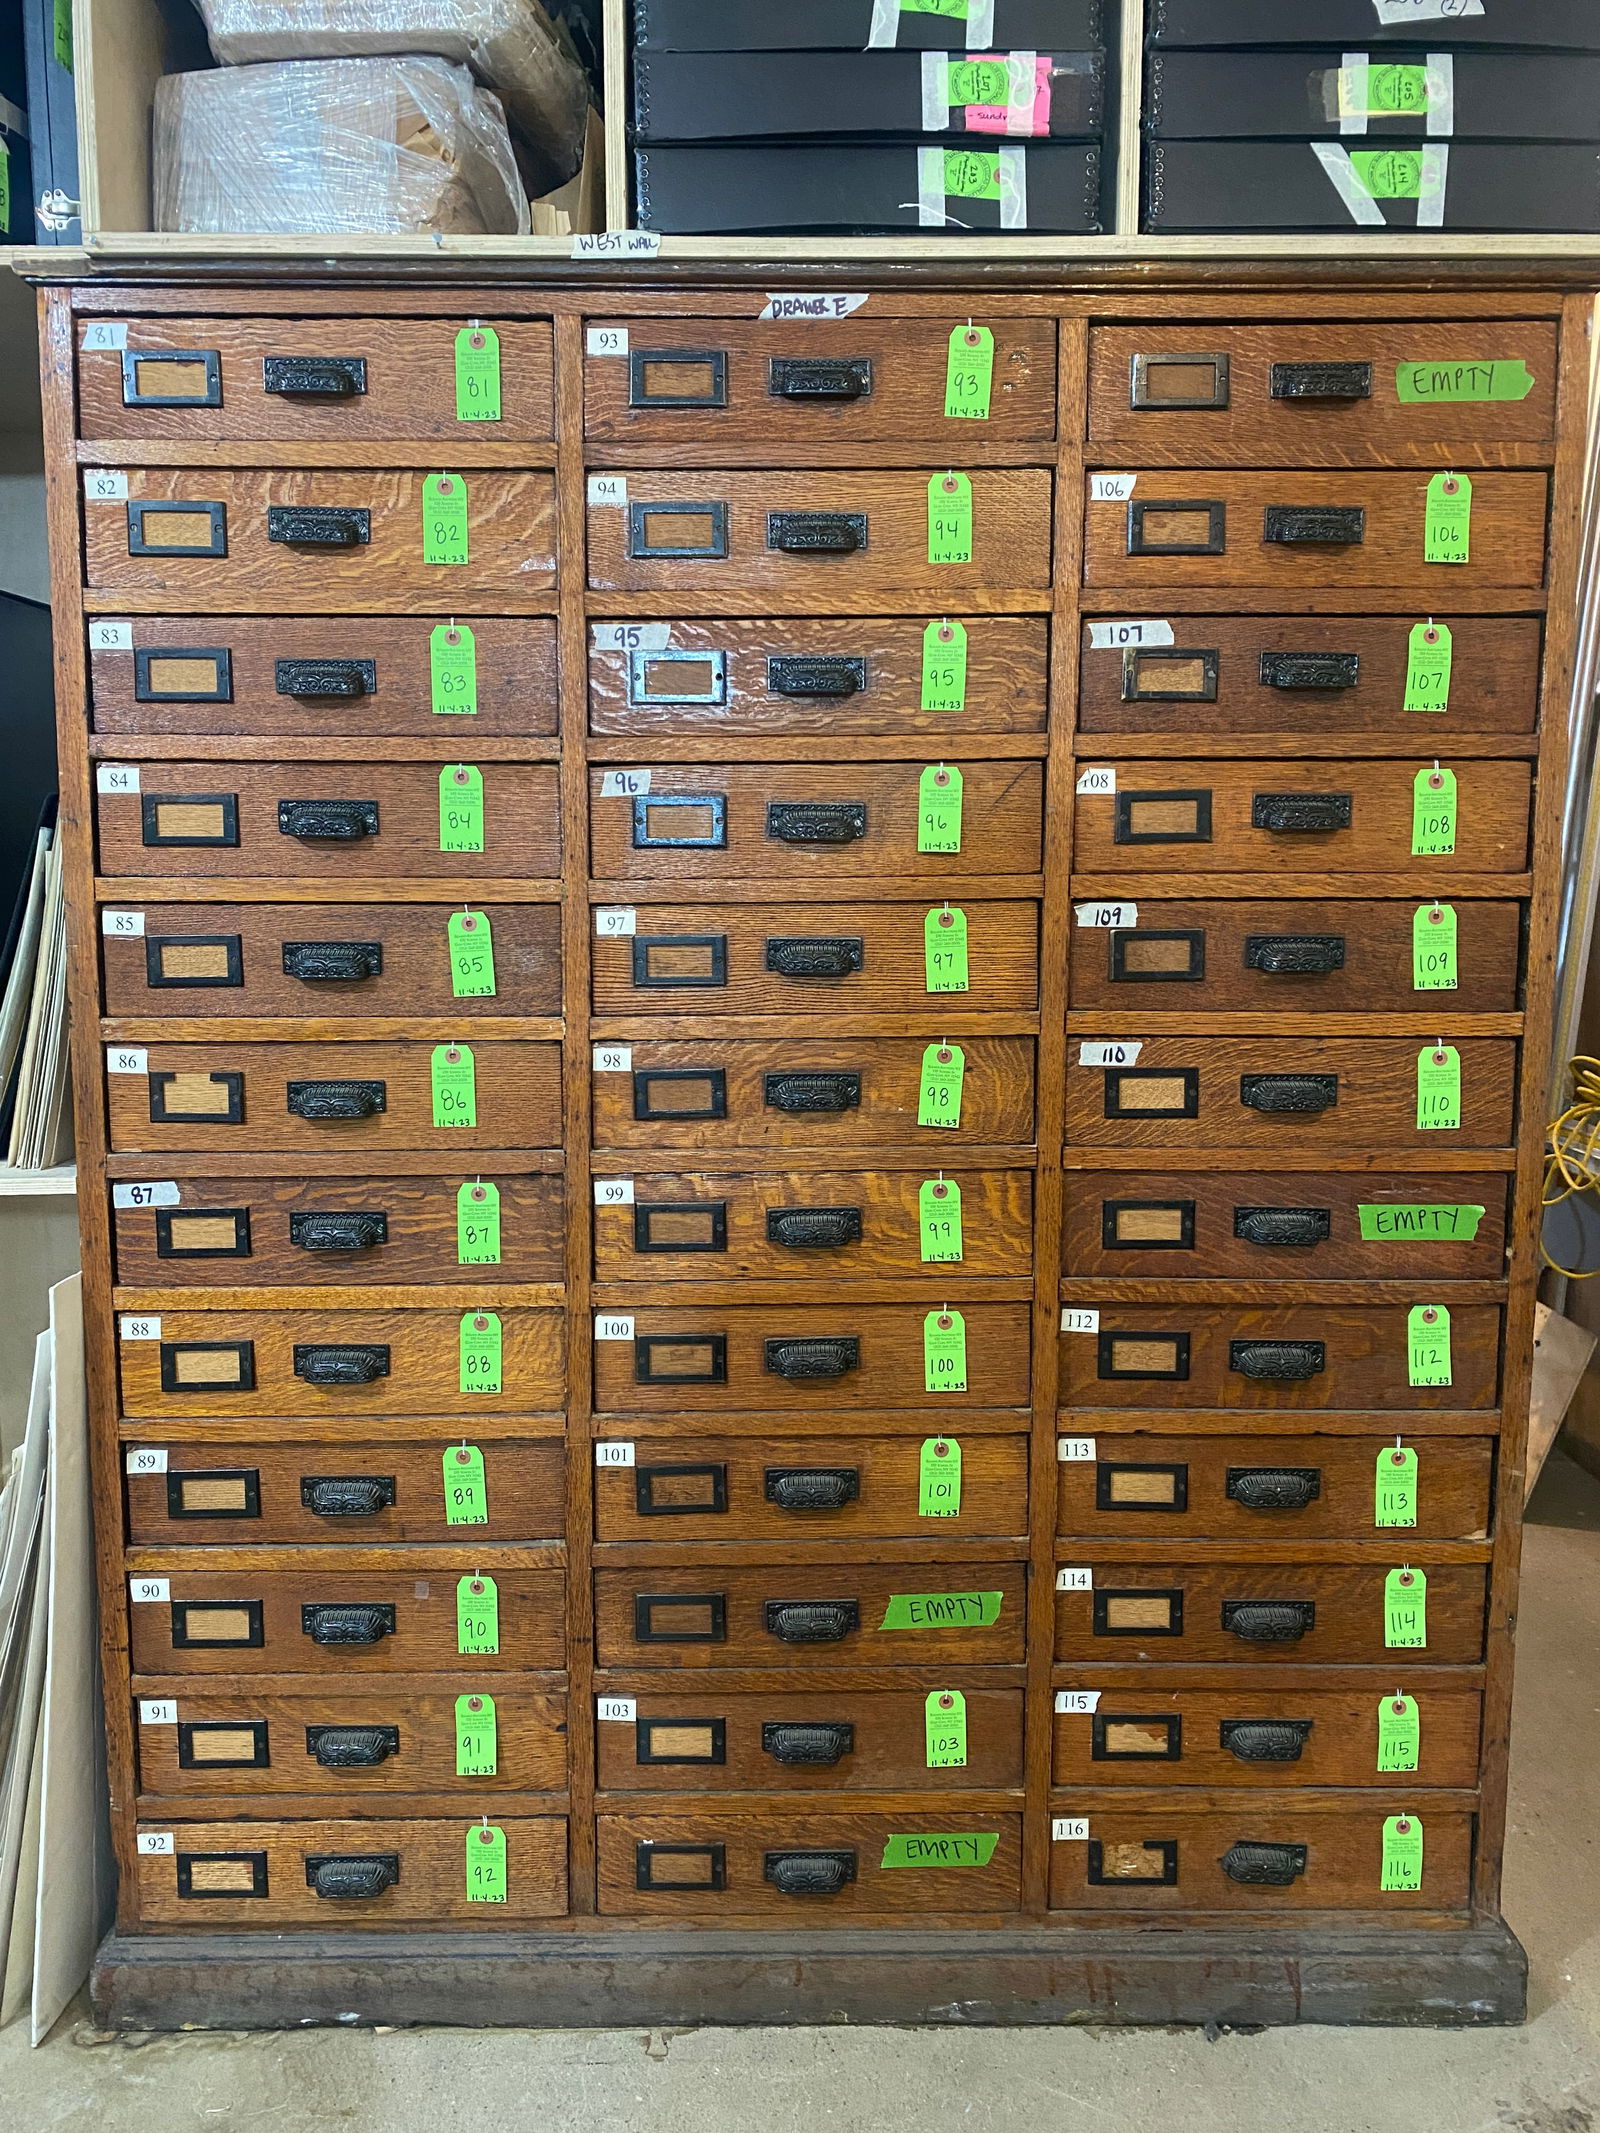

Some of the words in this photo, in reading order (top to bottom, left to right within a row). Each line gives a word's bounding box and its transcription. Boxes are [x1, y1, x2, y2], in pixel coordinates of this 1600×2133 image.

[969, 165, 978, 184] 203
[580, 234, 622, 251] WEST
[832, 297, 848, 316] E
[95, 327, 114, 346] 81
[600, 333, 617, 348] 93
[467, 377, 487, 397] 81
[954, 373, 978, 396] 93
[1412, 363, 1494, 394] EMPTY
[97, 480, 115, 494] 82
[598, 482, 616, 494] 94
[1100, 481, 1124, 496] 106
[434, 522, 459, 544] 82
[936, 520, 957, 540] 94
[1433, 526, 1459, 543] 106
[102, 629, 118, 643] 83
[614, 626, 642, 648] 95
[1110, 625, 1142, 644] 107
[441, 672, 466, 693] 83
[930, 669, 954, 687] 95
[1412, 672, 1442, 690] 107
[111, 773, 128, 787] 84
[615, 773, 638, 793] 96
[448, 812, 470, 828] 84
[926, 814, 947, 831] 96
[1423, 816, 1449, 836] 108
[116, 917, 133, 930] 85
[608, 917, 624, 930] 97
[1094, 907, 1122, 927] 109
[459, 956, 483, 975] 85
[934, 953, 953, 970] 97
[1420, 952, 1447, 972] 109
[119, 1055, 136, 1068] 86
[604, 1054, 620, 1067] 98
[1103, 1046, 1125, 1063] 110
[441, 1089, 466, 1110] 86
[928, 1087, 948, 1106] 98
[1424, 1096, 1449, 1114] 110
[131, 1186, 152, 1204] 87
[606, 1187, 623, 1200] 99
[1376, 1207, 1459, 1233] EMPTY
[466, 1226, 488, 1244] 87
[929, 1222, 950, 1240] 99
[132, 1323, 148, 1336] 88
[605, 1323, 628, 1335] 100
[1067, 1314, 1092, 1328] 112
[467, 1355, 490, 1373] 88
[931, 1359, 954, 1374] 100
[1415, 1349, 1442, 1368] 112
[605, 1449, 626, 1461] 101
[1066, 1444, 1088, 1456] 113
[138, 1455, 155, 1468] 89
[454, 1488, 473, 1505] 89
[929, 1483, 951, 1498] 101
[1384, 1493, 1407, 1511] 113
[1063, 1574, 1086, 1586] 114
[142, 1585, 159, 1597] 90
[909, 1594, 983, 1623] EMPTY
[465, 1618, 486, 1639] 90
[1392, 1611, 1415, 1632] 114
[606, 1704, 628, 1716] 103
[1065, 1695, 1087, 1709] 115
[152, 1707, 166, 1719] 91
[463, 1736, 480, 1757] 91
[933, 1737, 959, 1753] 103
[1385, 1741, 1410, 1757] 115
[1060, 1823, 1083, 1835] 116
[148, 1838, 165, 1850] 92
[906, 1838, 978, 1860] EMPTY
[475, 1866, 496, 1884] 92
[1390, 1861, 1411, 1876] 116
